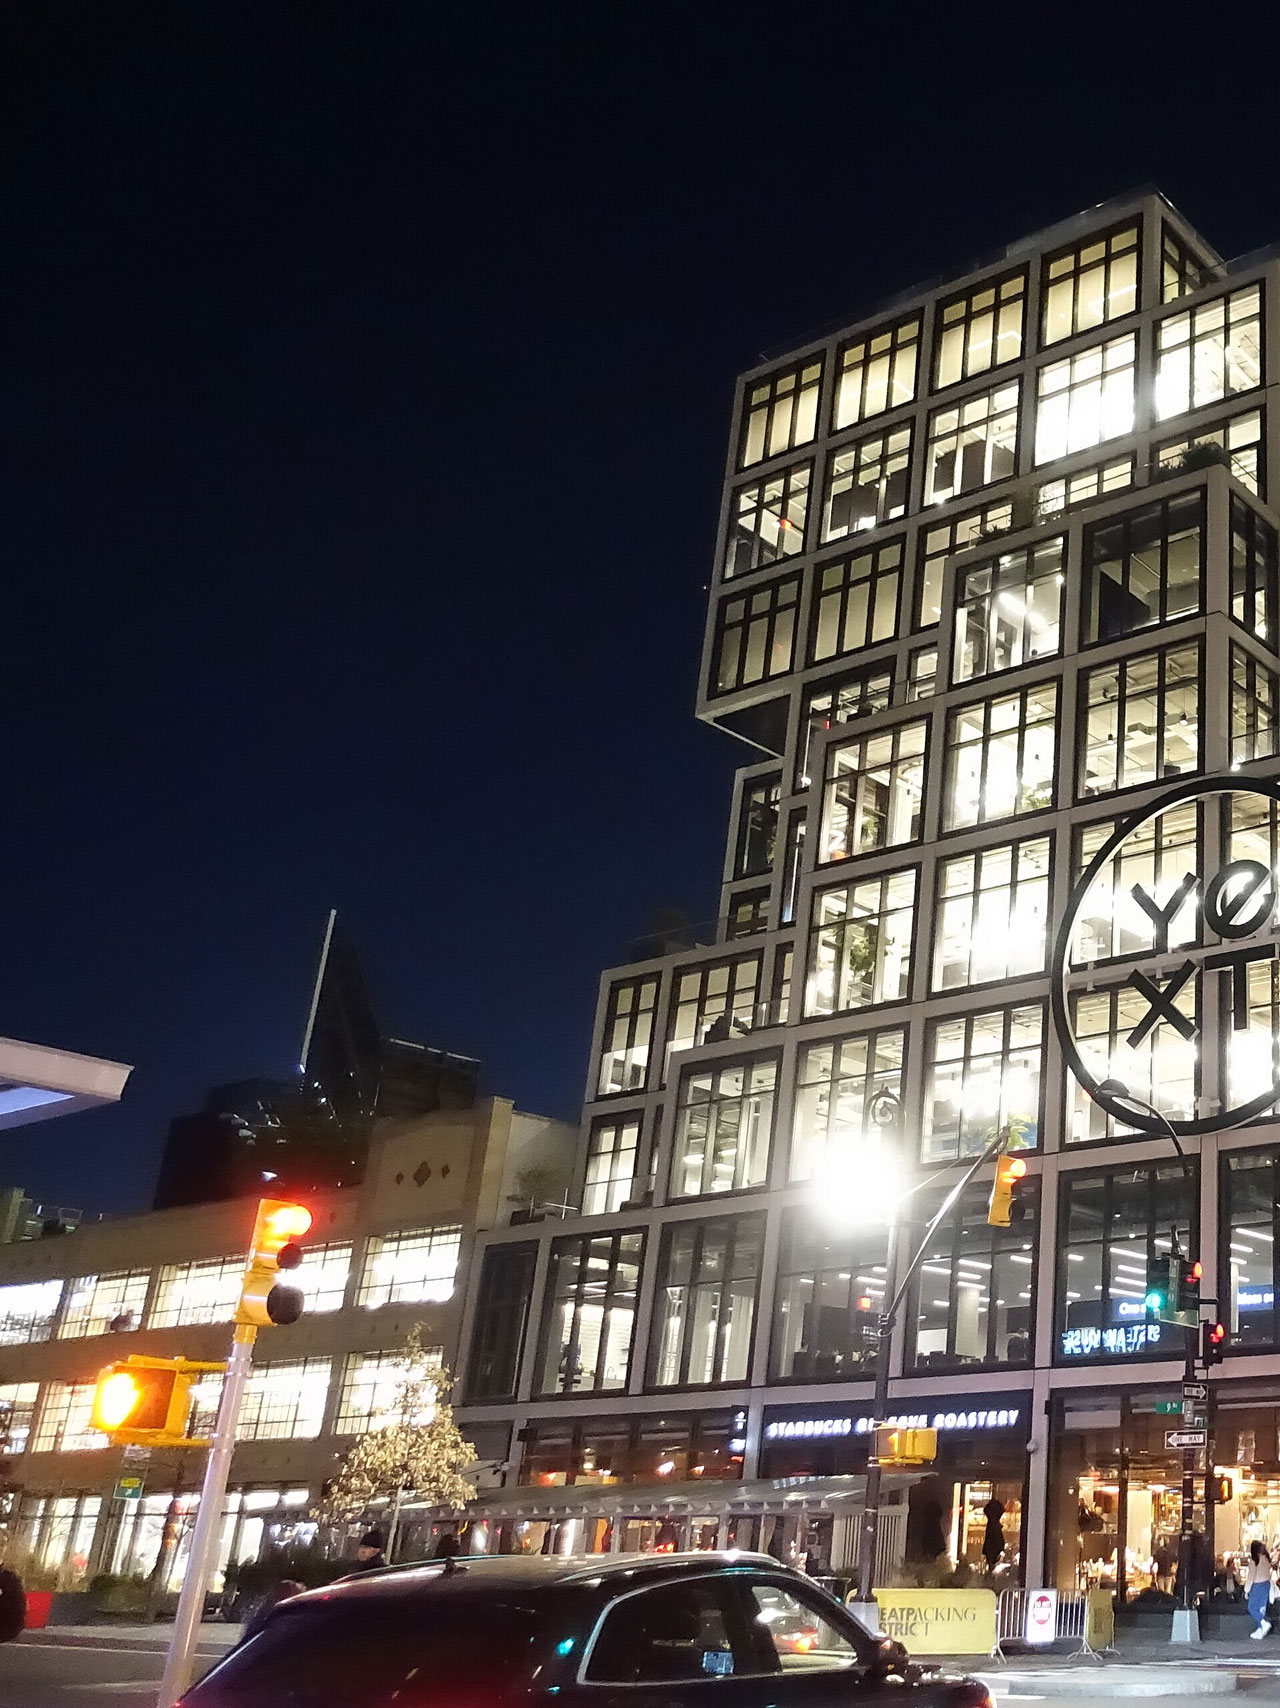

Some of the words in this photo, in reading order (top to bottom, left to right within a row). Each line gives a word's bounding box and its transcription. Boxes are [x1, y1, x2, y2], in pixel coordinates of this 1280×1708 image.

[768, 1418, 851, 1437] STARBUCKS
[856, 1414, 927, 1434] REERVE
[933, 1410, 1019, 1429] ROASTERY
[880, 1607, 977, 1621] EATPACKING
[880, 1621, 929, 1637] STRICT
